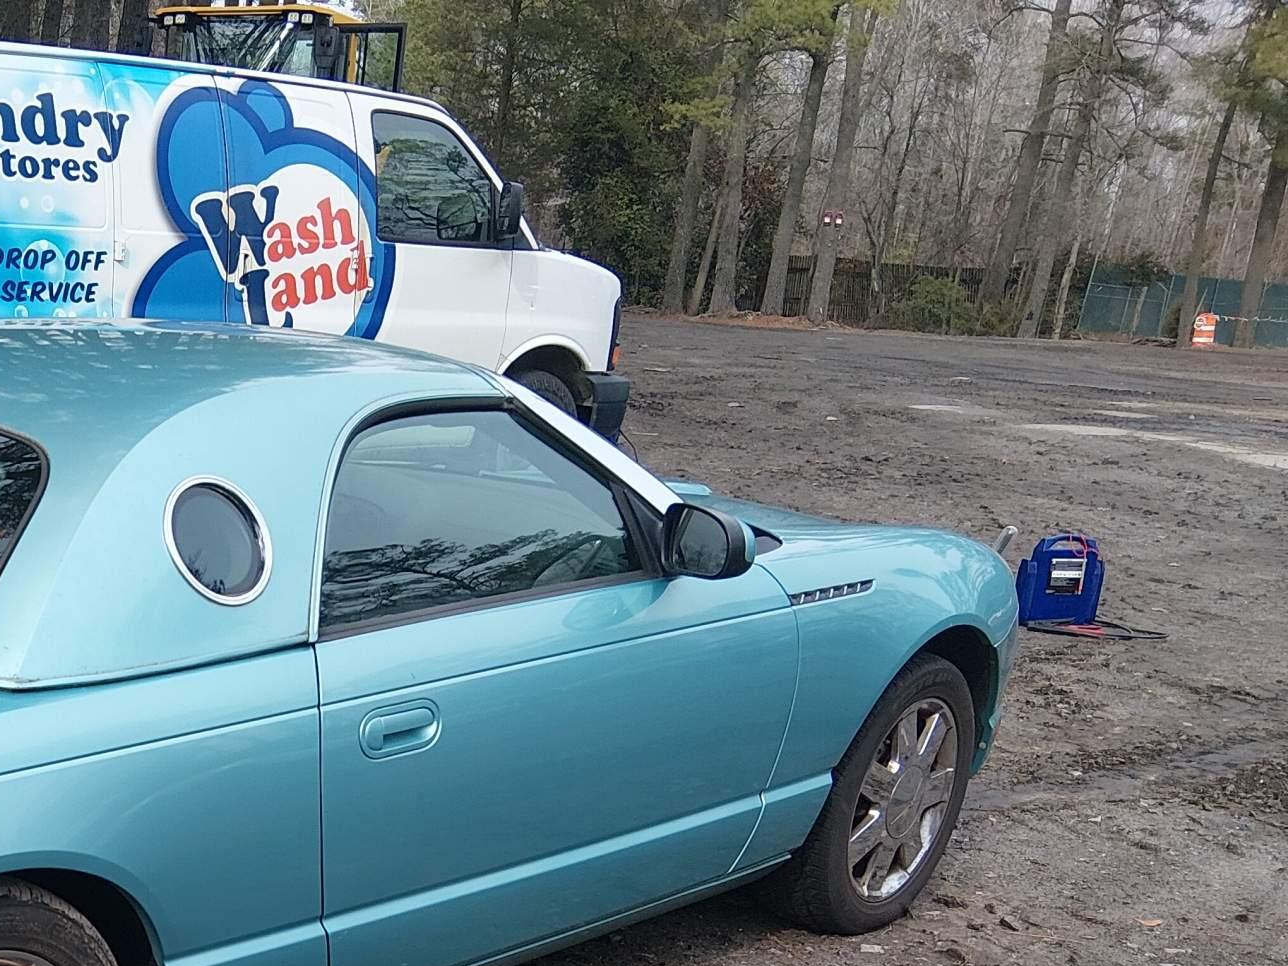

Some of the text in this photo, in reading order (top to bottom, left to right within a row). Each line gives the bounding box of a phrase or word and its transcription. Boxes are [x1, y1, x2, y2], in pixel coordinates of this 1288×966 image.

[195, 185, 356, 275] Wash
[65, 250, 108, 272] OFF
[239, 239, 369, 328] Land
[0, 281, 99, 304] SERVICE
